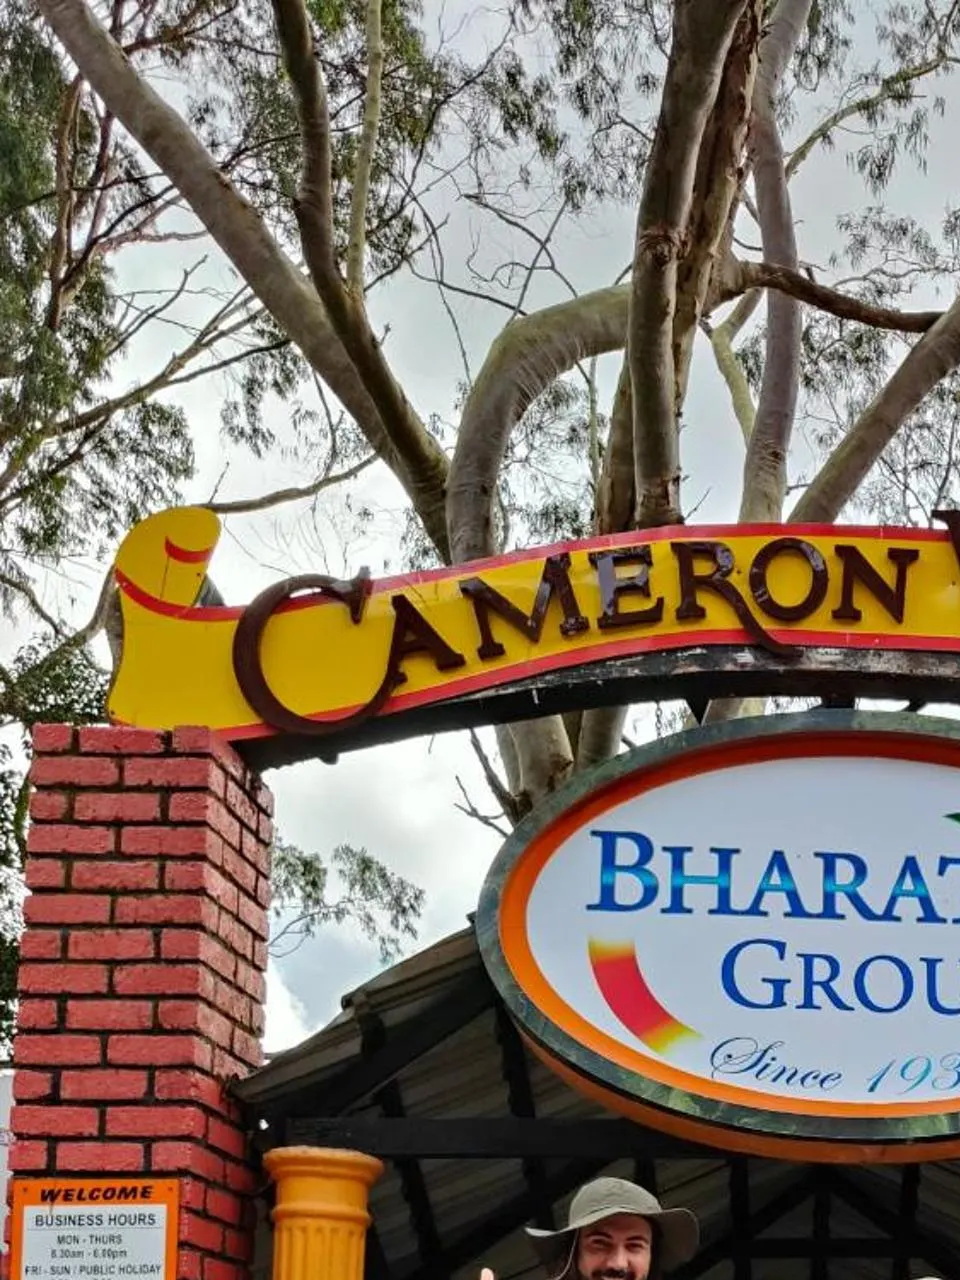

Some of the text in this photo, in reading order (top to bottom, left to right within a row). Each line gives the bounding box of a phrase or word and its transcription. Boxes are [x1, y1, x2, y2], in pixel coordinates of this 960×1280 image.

[232, 537, 919, 735] CAMERON
[709, 1036, 843, 1091] Since
[40, 1185, 154, 1202] WELCOME
[35, 1213, 156, 1227] BUSINESS HOURS
[57, 1234, 79, 1245] MON
[89, 1234, 123, 1245] THURS
[25, 1265, 42, 1275] FRI
[50, 1265, 71, 1275] SUN
[79, 1264, 115, 1275] PUBLIC
[119, 1264, 161, 1275] HOLIDAY
